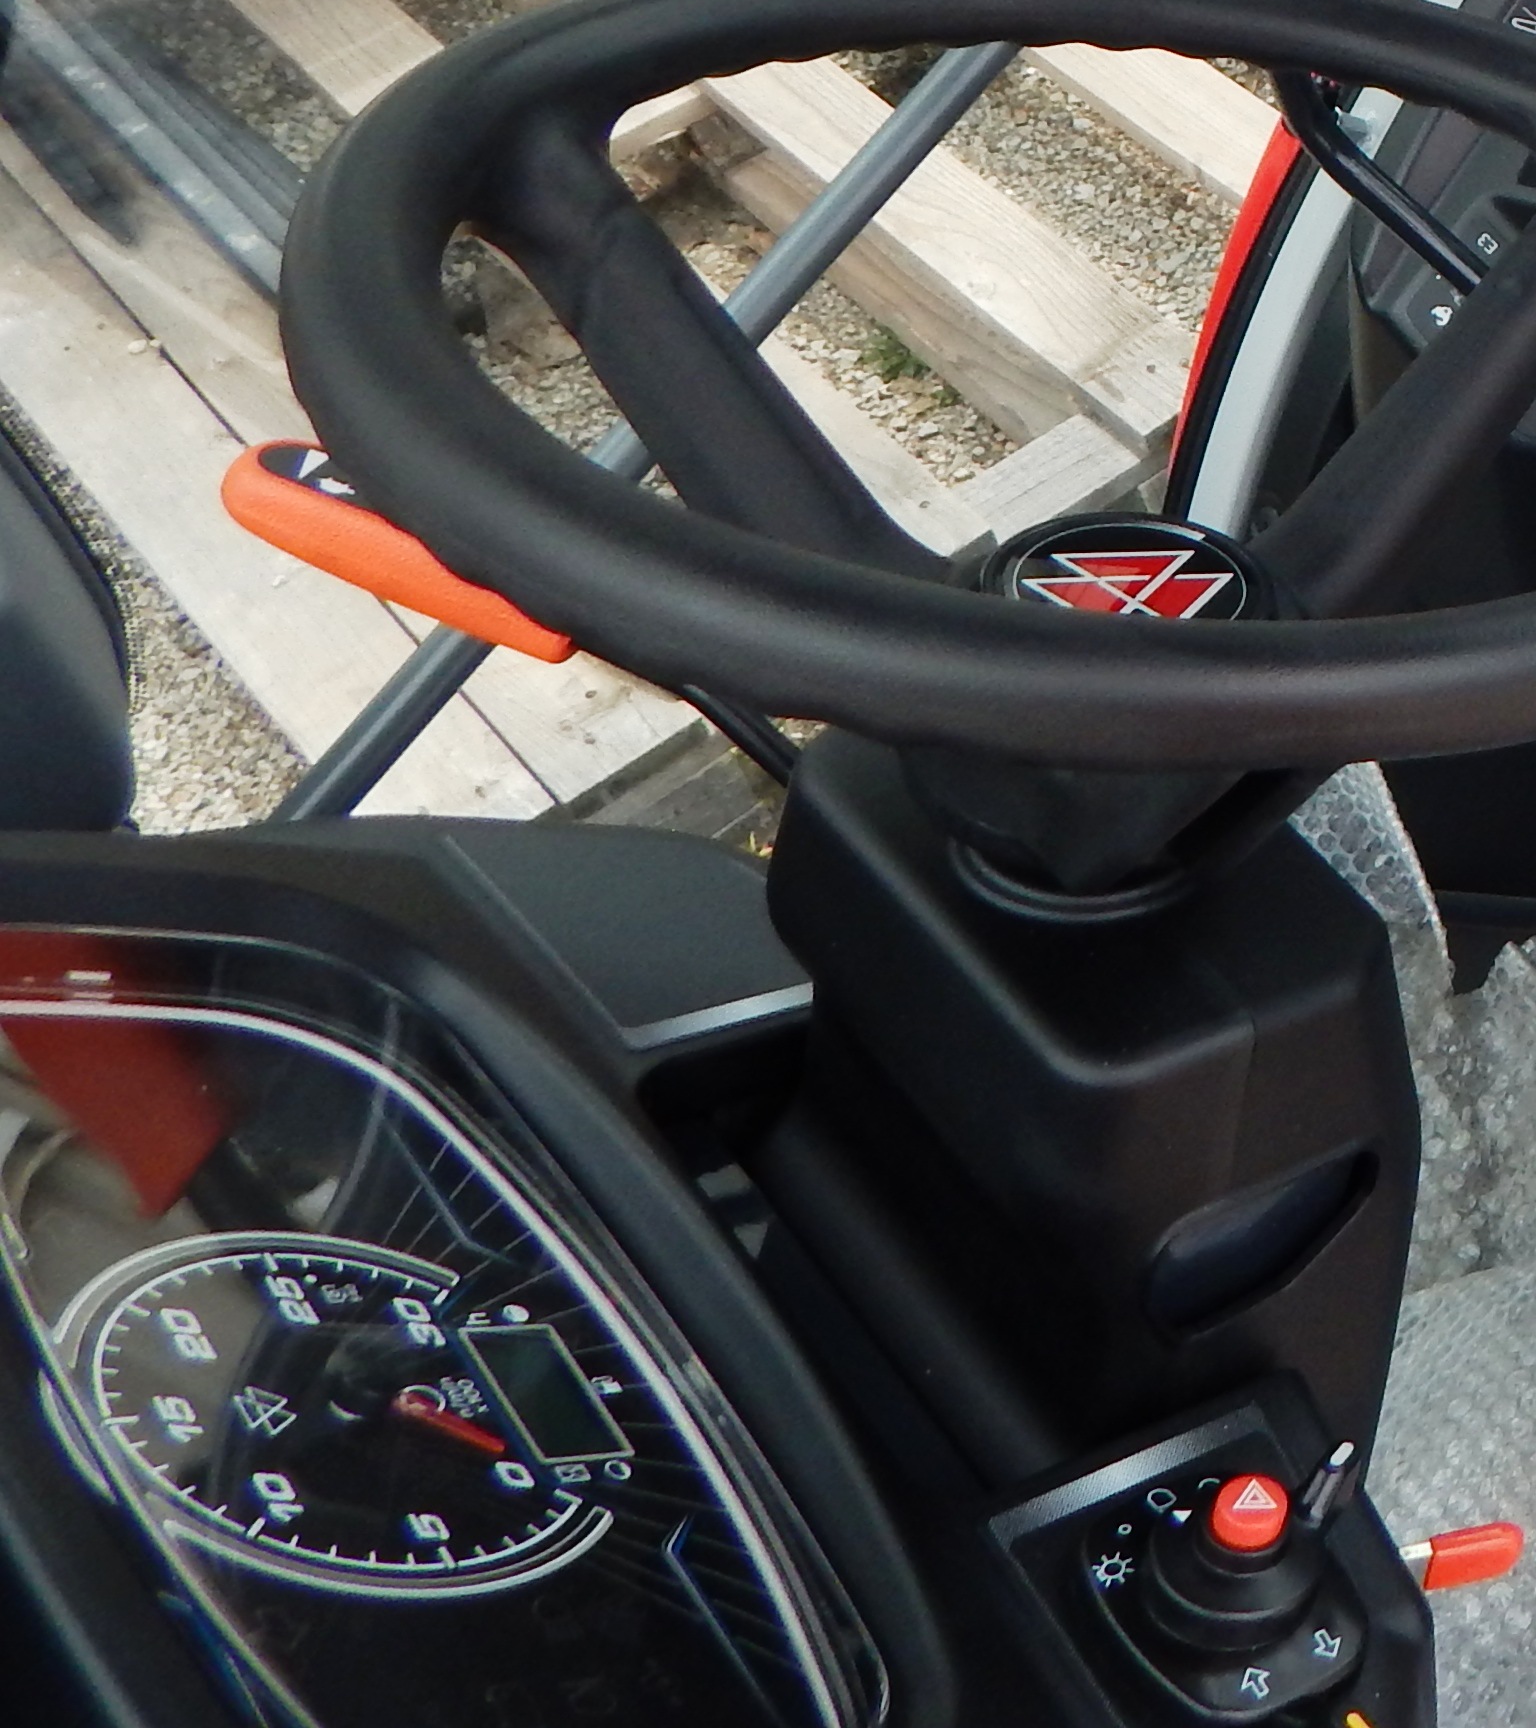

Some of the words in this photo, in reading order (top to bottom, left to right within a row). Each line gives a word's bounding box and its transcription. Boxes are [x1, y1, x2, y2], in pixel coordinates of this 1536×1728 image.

[1477, 232, 1499, 255] E3
[265, 1275, 320, 1325] 25
[393, 1297, 446, 1347] 30
[160, 1307, 217, 1360] 20
[153, 1394, 204, 1443] 15
[252, 1471, 304, 1522] 10
[494, 1460, 535, 1489] 0
[406, 1512, 451, 1543] 5
